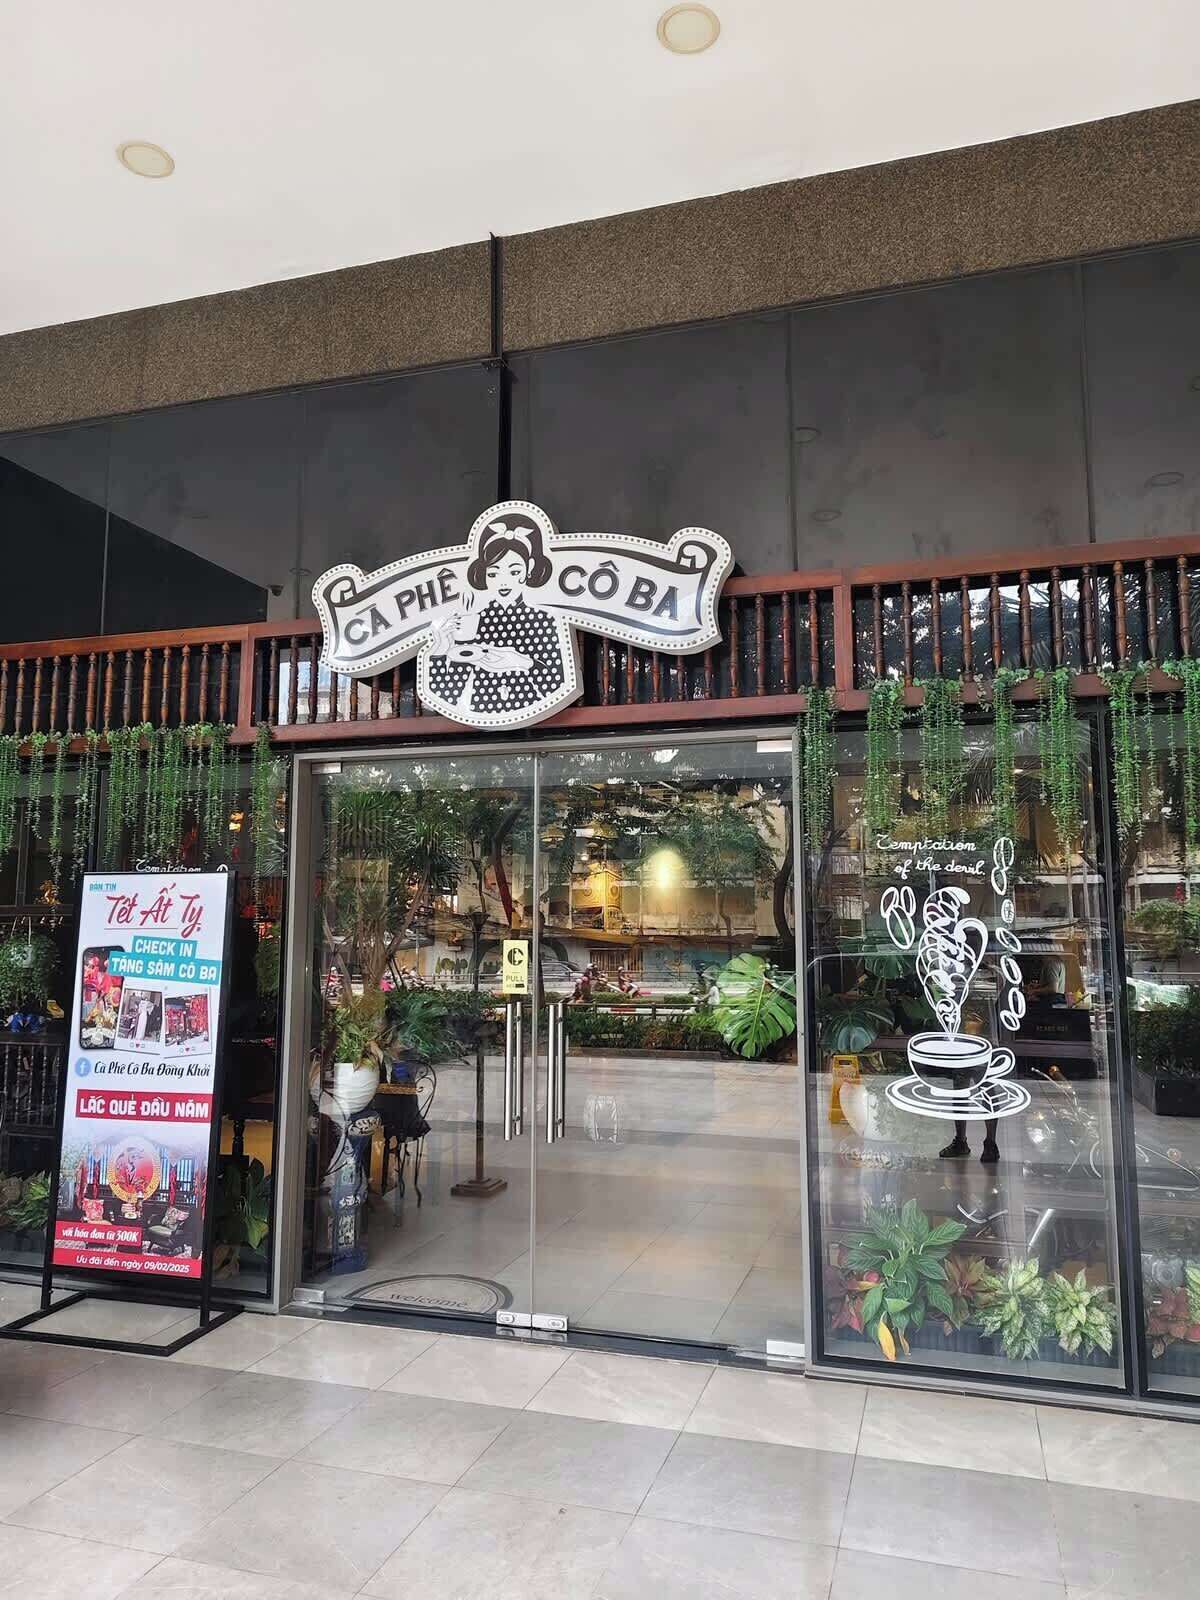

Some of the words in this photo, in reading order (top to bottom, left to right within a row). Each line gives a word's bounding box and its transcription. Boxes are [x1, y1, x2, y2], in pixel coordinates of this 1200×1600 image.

[394, 568, 460, 621] PHÊ
[559, 560, 620, 600] CÔ
[625, 576, 679, 621] BA
[876, 834, 976, 855] Temptation
[894, 859, 912, 880] of
[915, 857, 942, 871] the
[105, 882, 117, 891] TIN
[106, 893, 138, 924] Tết
[140, 883, 176, 926] Ất
[180, 894, 203, 938] Tỵ
[135, 939, 176, 956] CHECK
[179, 943, 193, 958] IN
[112, 956, 144, 976] TẶNG
[147, 959, 175, 976] SÂM
[179, 962, 196, 979] CÔ
[199, 965, 217, 981] BA
[505, 975, 525, 983] PULL
[94, 1061, 106, 1074] Cà
[108, 1061, 126, 1075] Phê
[127, 1062, 139, 1075] Cô
[140, 1062, 154, 1076] Ba
[156, 1063, 184, 1079] Đồng
[186, 1063, 210, 1077] Khởi
[80, 1095, 106, 1114] LẮC
[140, 1096, 170, 1117] ĐẦU
[174, 1099, 209, 1118] NĂM
[76, 1254, 87, 1264] Ưu
[121, 1259, 143, 1271] ngày
[144, 1262, 190, 1274] 09/02/2025
